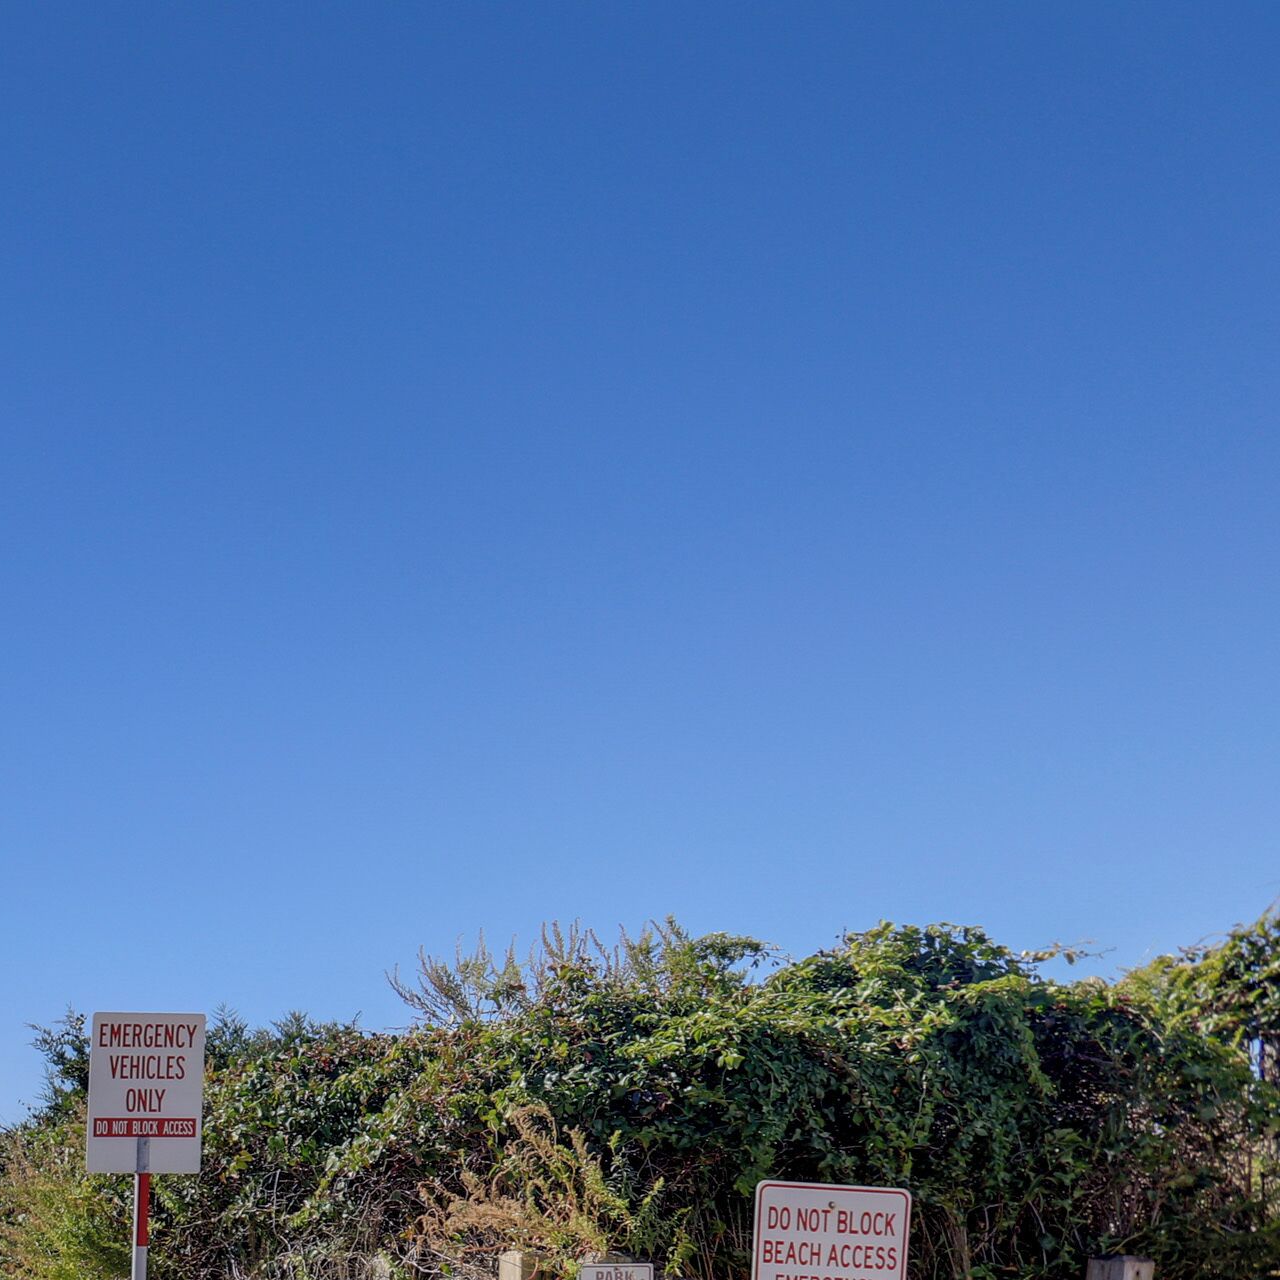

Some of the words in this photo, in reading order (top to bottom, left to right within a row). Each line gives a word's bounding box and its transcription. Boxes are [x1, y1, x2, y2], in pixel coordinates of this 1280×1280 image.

[99, 1024, 198, 1048] EMERGENCY
[110, 1055, 186, 1080] VEHICLES
[126, 1088, 166, 1113] ONLY
[96, 1121, 108, 1135] DO
[112, 1121, 128, 1135] NOT
[132, 1121, 159, 1135] BLOCK
[163, 1121, 194, 1135] ACCESS
[768, 1206, 791, 1231] DO
[796, 1208, 831, 1233] NOT
[837, 1210, 896, 1237] BLOCK
[763, 1240, 822, 1266] BEACH
[827, 1244, 897, 1270] ACCESS
